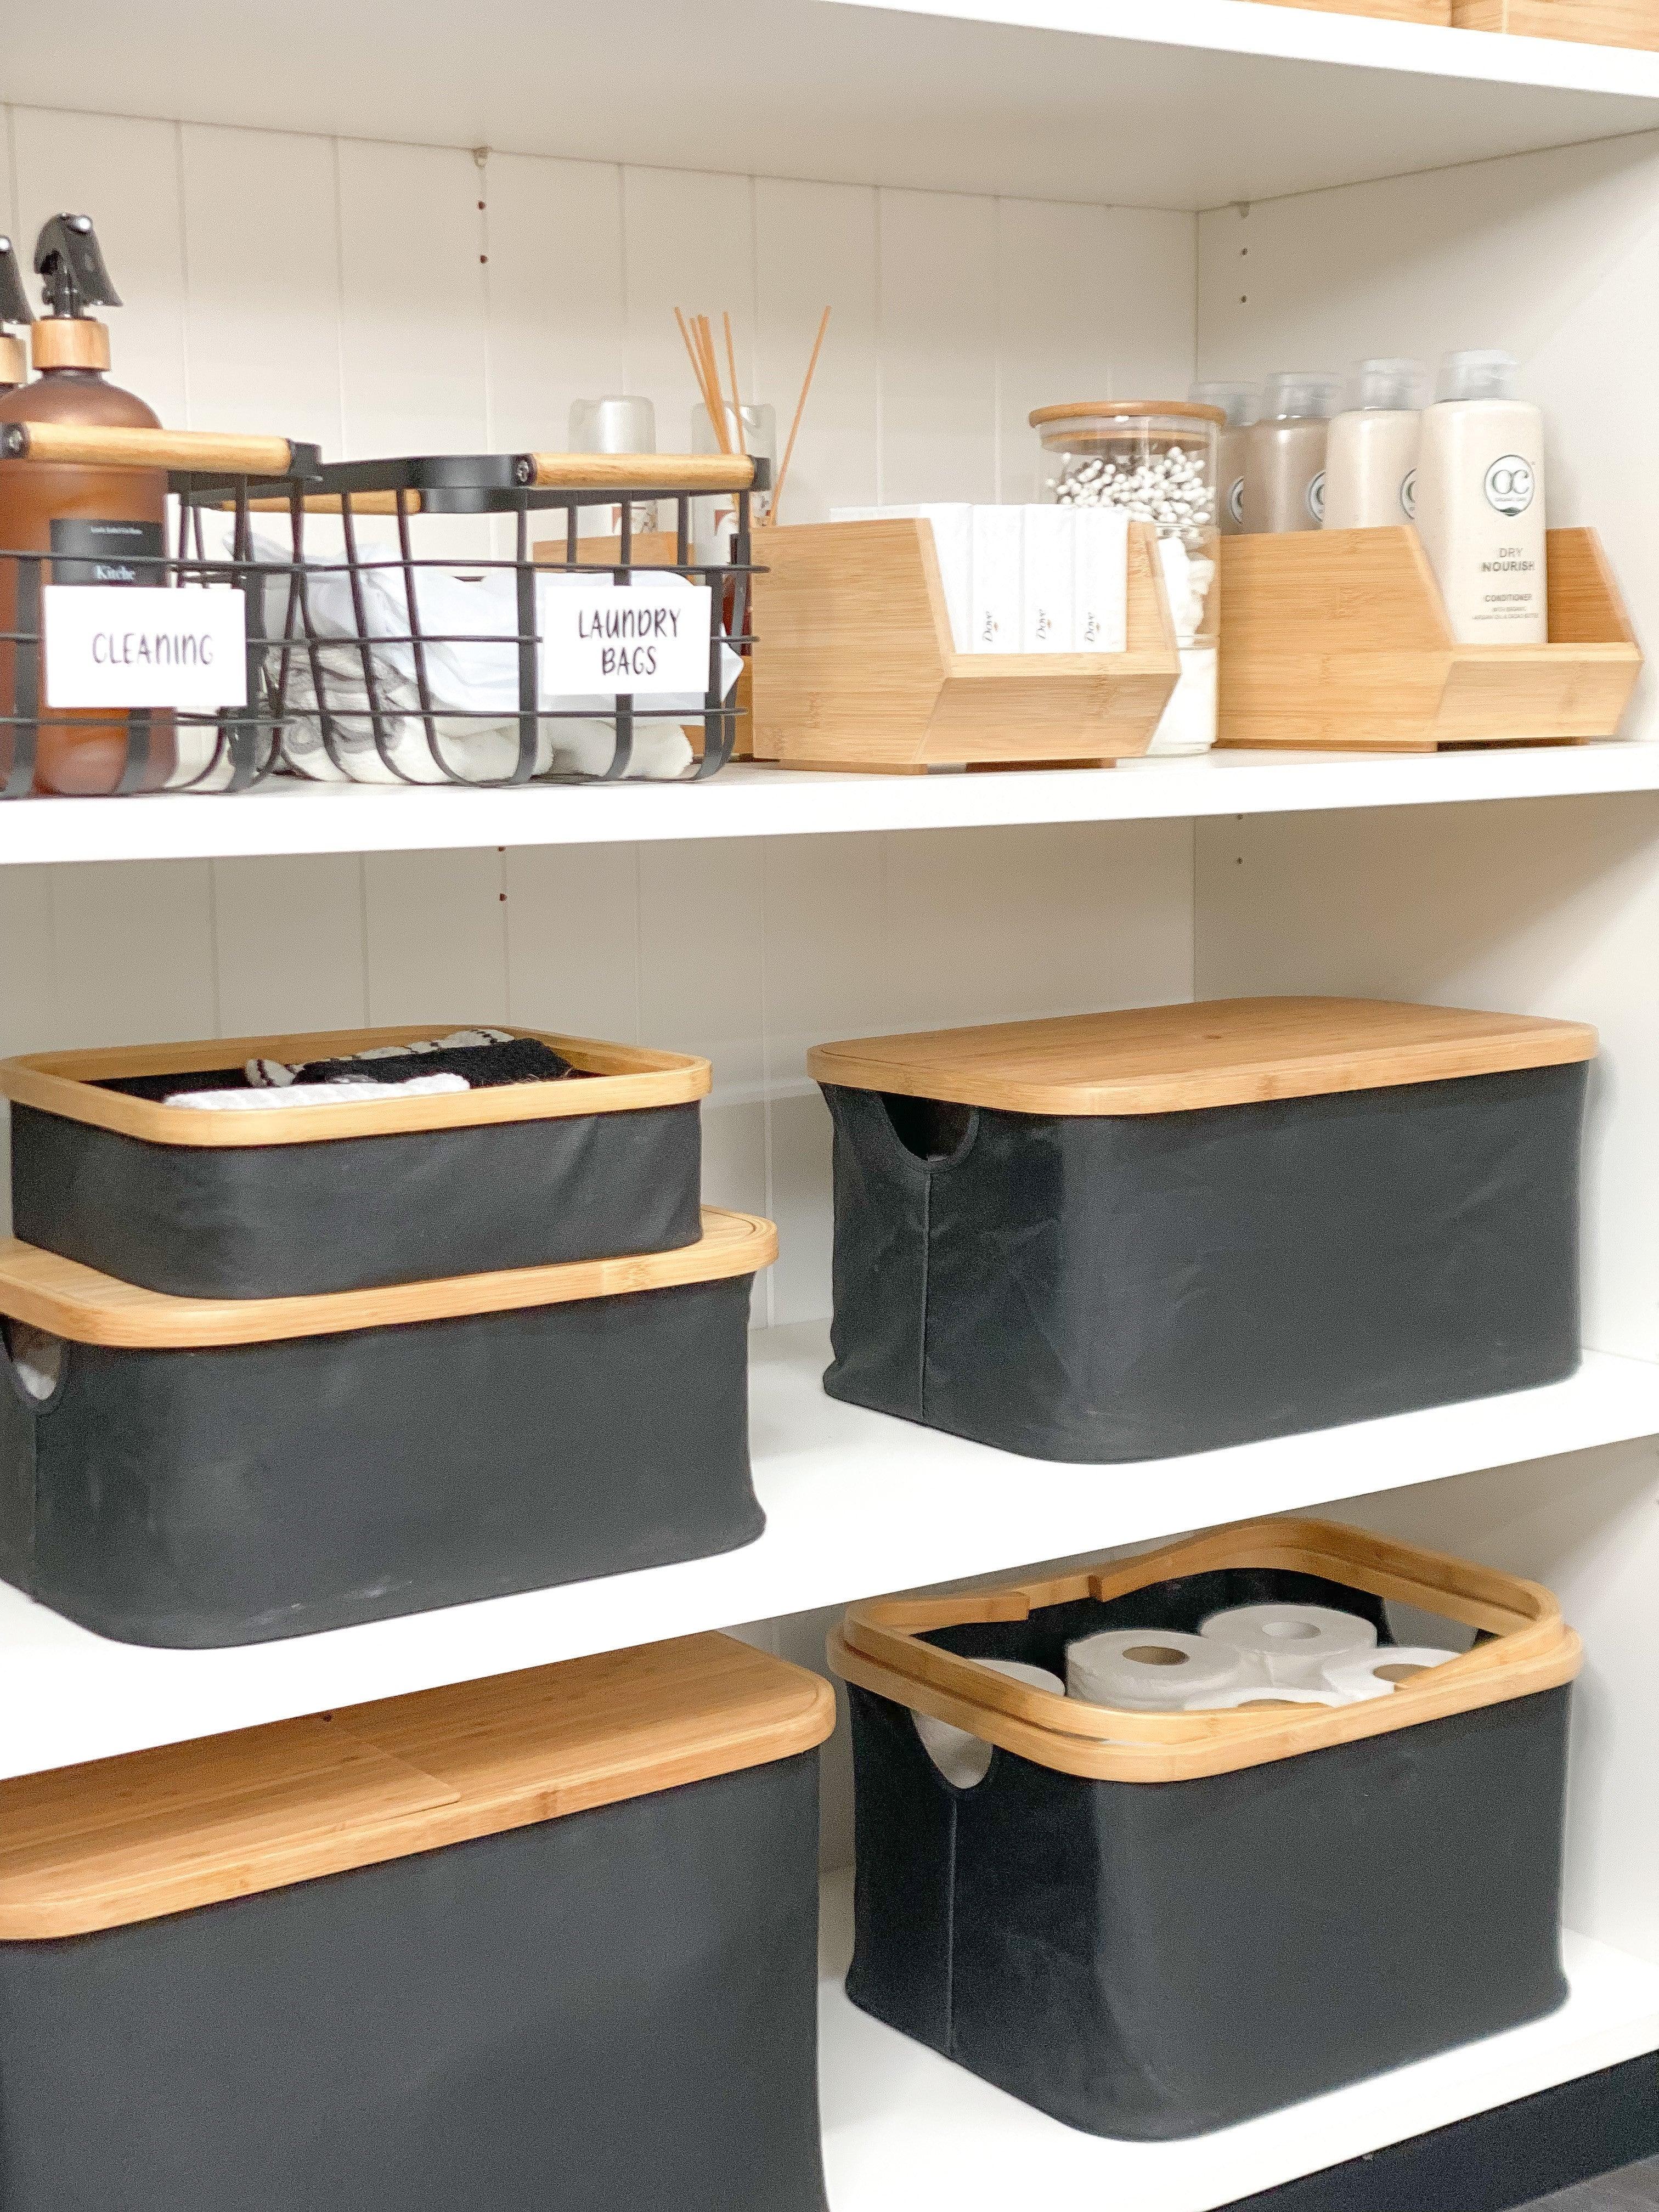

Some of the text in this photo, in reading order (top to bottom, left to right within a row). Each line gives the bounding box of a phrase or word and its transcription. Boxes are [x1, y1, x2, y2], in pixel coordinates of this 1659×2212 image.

[1491, 469, 1530, 495] OC
[1481, 561, 1535, 572] NOURISH
[1499, 548, 1523, 557] DRY
[1483, 594, 1532, 602] CONDITIONER
[578, 608, 681, 639] LAUNDRY
[983, 611, 992, 642] Dove
[1036, 609, 1046, 639] Dove
[1084, 612, 1095, 642] Dove
[92, 633, 213, 665] CLEANING
[602, 646, 657, 675] BAGS
